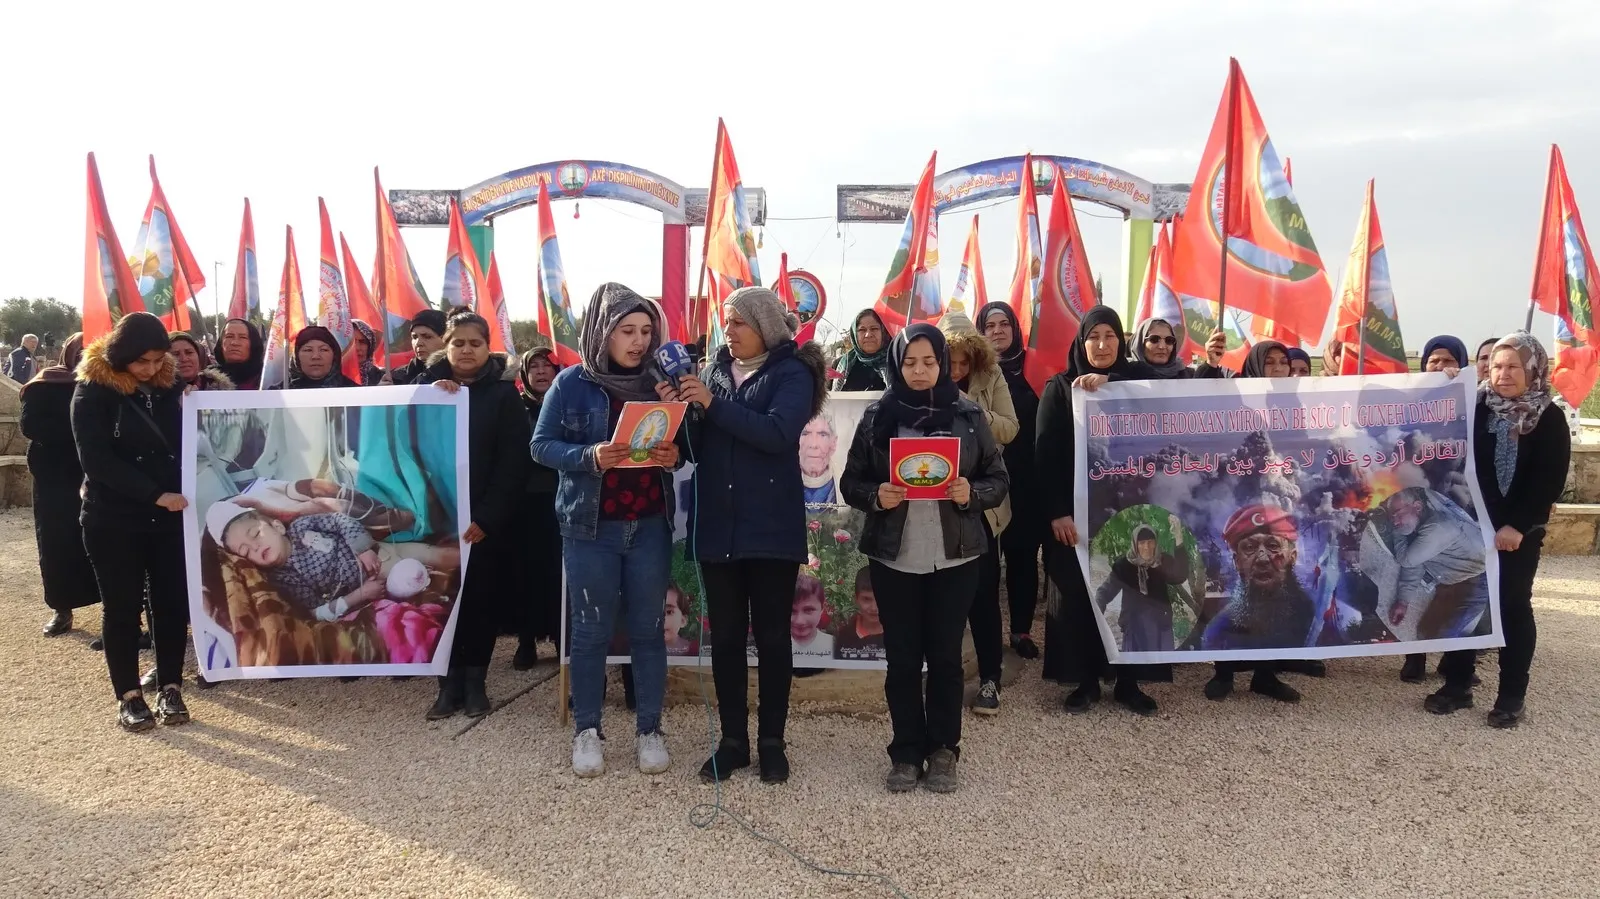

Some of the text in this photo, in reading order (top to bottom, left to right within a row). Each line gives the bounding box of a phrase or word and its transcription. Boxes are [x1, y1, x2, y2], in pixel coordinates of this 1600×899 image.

[659, 349, 673, 366] R
[674, 343, 688, 357] R
[1161, 409, 1226, 435] ERDOXAN
[1358, 403, 1407, 428] GUNEH
[1089, 439, 1467, 481] القاتل أردوغان لا يميز بين المعاق والمسن
